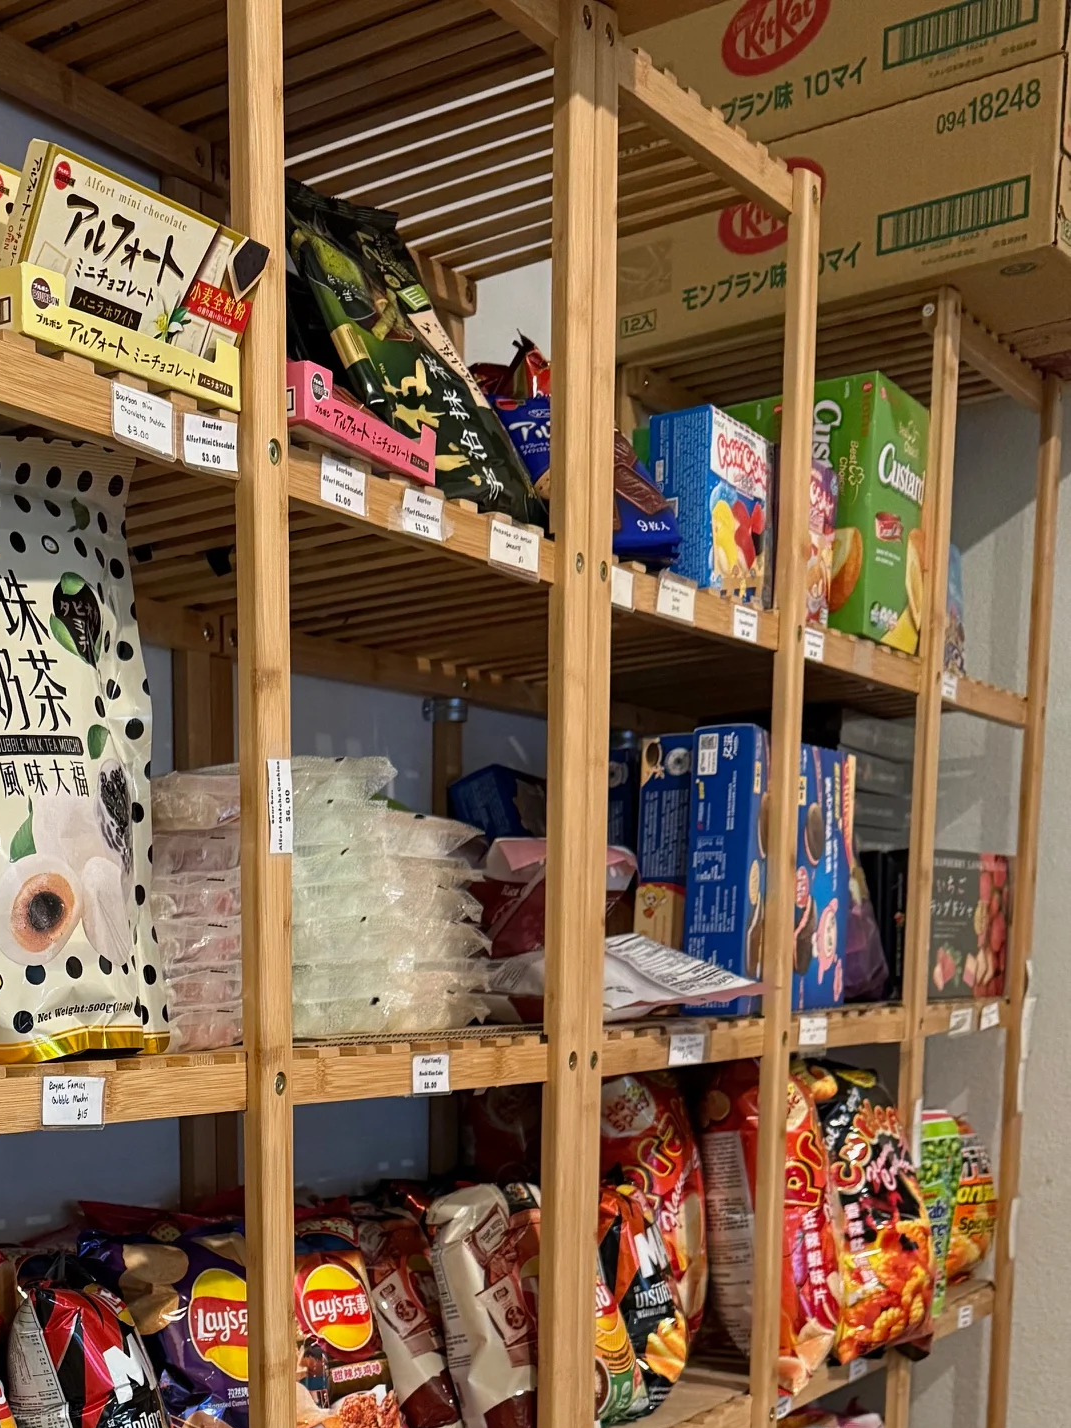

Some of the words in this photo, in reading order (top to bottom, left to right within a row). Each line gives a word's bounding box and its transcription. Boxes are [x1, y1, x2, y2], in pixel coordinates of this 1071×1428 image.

[84, 174, 116, 198] Alfort
[117, 191, 141, 211] mini
[143, 203, 188, 233] chocolate
[63, 193, 185, 286] アルフォート
[75, 257, 155, 307] ミニチョコレート
[68, 319, 129, 358] アルフォート
[133, 348, 196, 384] ミニチョコレート
[333, 409, 370, 442] アルフォート
[372, 432, 409, 462] ミニチョコレート
[202, 453, 221, 464] $3.00
[27, 738, 45, 753] MILK
[45, 739, 57, 754] TEA
[59, 739, 81, 755] MOCHI
[0, 760, 90, 798] 風味大福
[37, 1011, 52, 1023] Net
[332, 1363, 382, 1383] 甜辣炸鸡味
